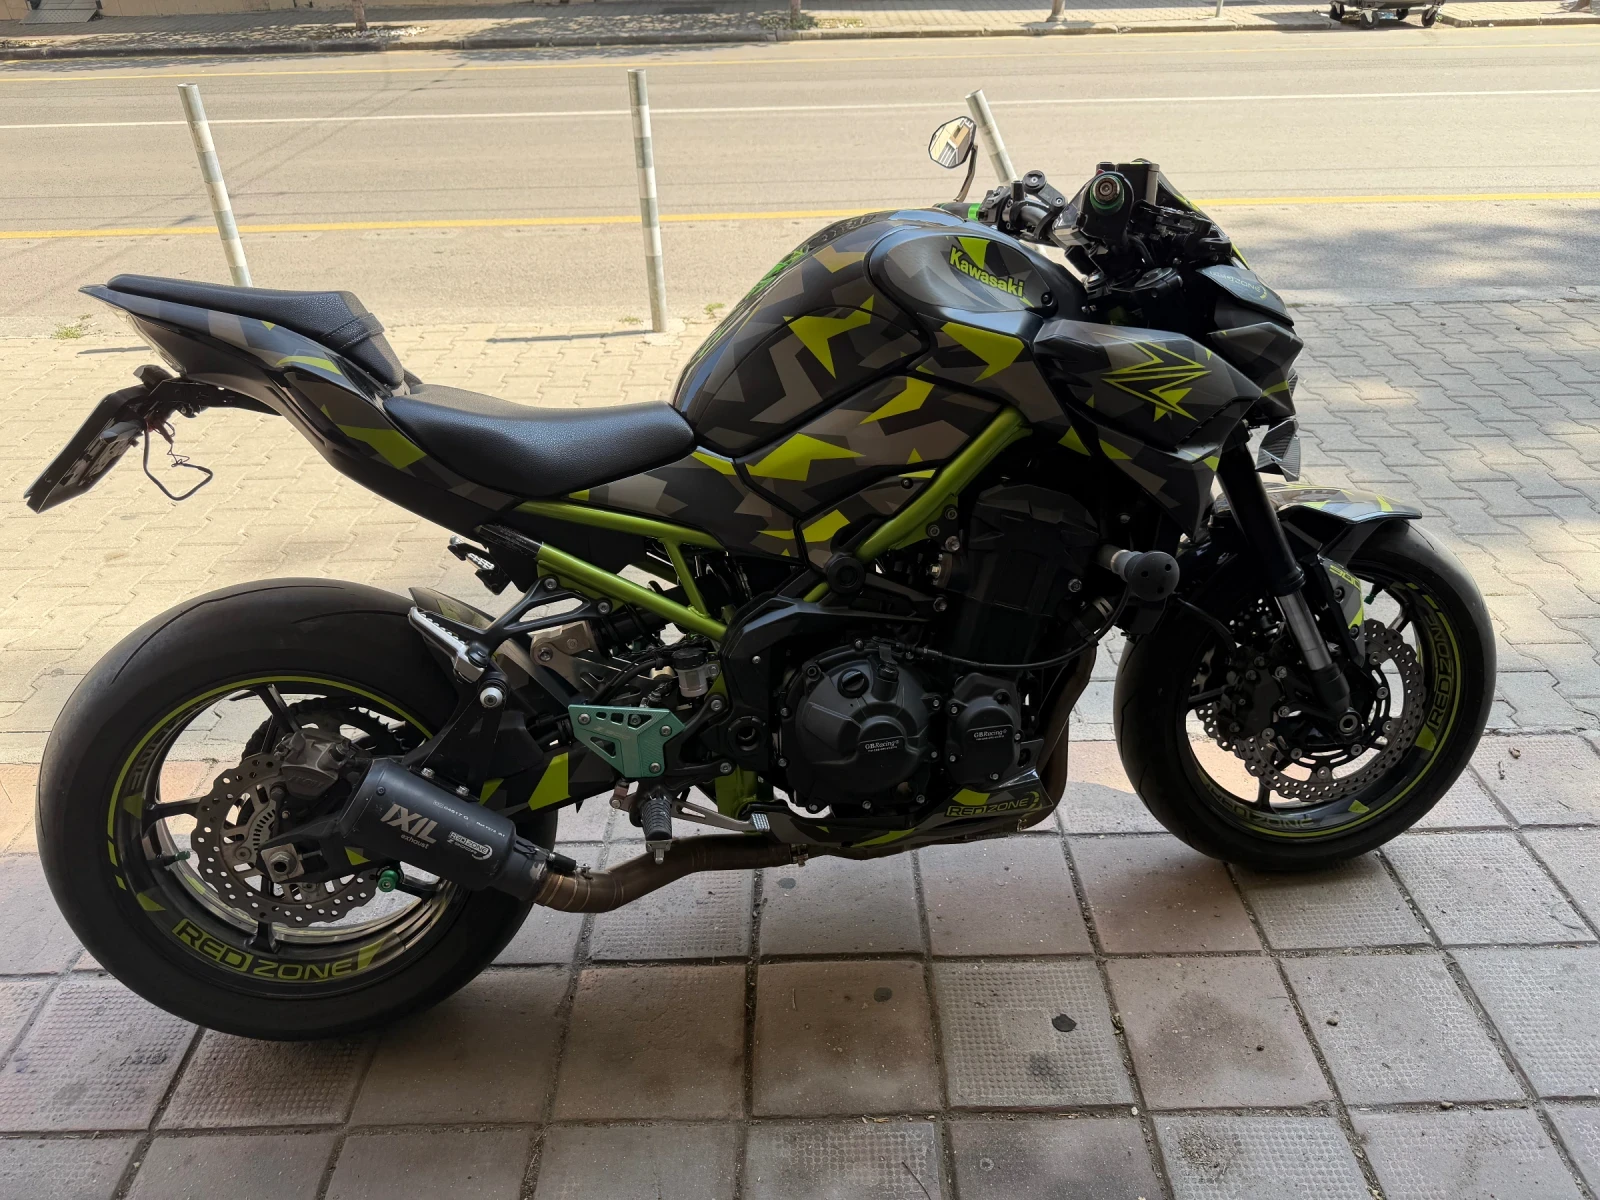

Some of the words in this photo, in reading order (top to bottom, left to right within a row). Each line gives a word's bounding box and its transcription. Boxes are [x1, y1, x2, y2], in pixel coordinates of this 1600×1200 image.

[949, 245, 1025, 297] Kawasaki
[380, 803, 438, 843] IXIL
[401, 833, 430, 850] exhaust
